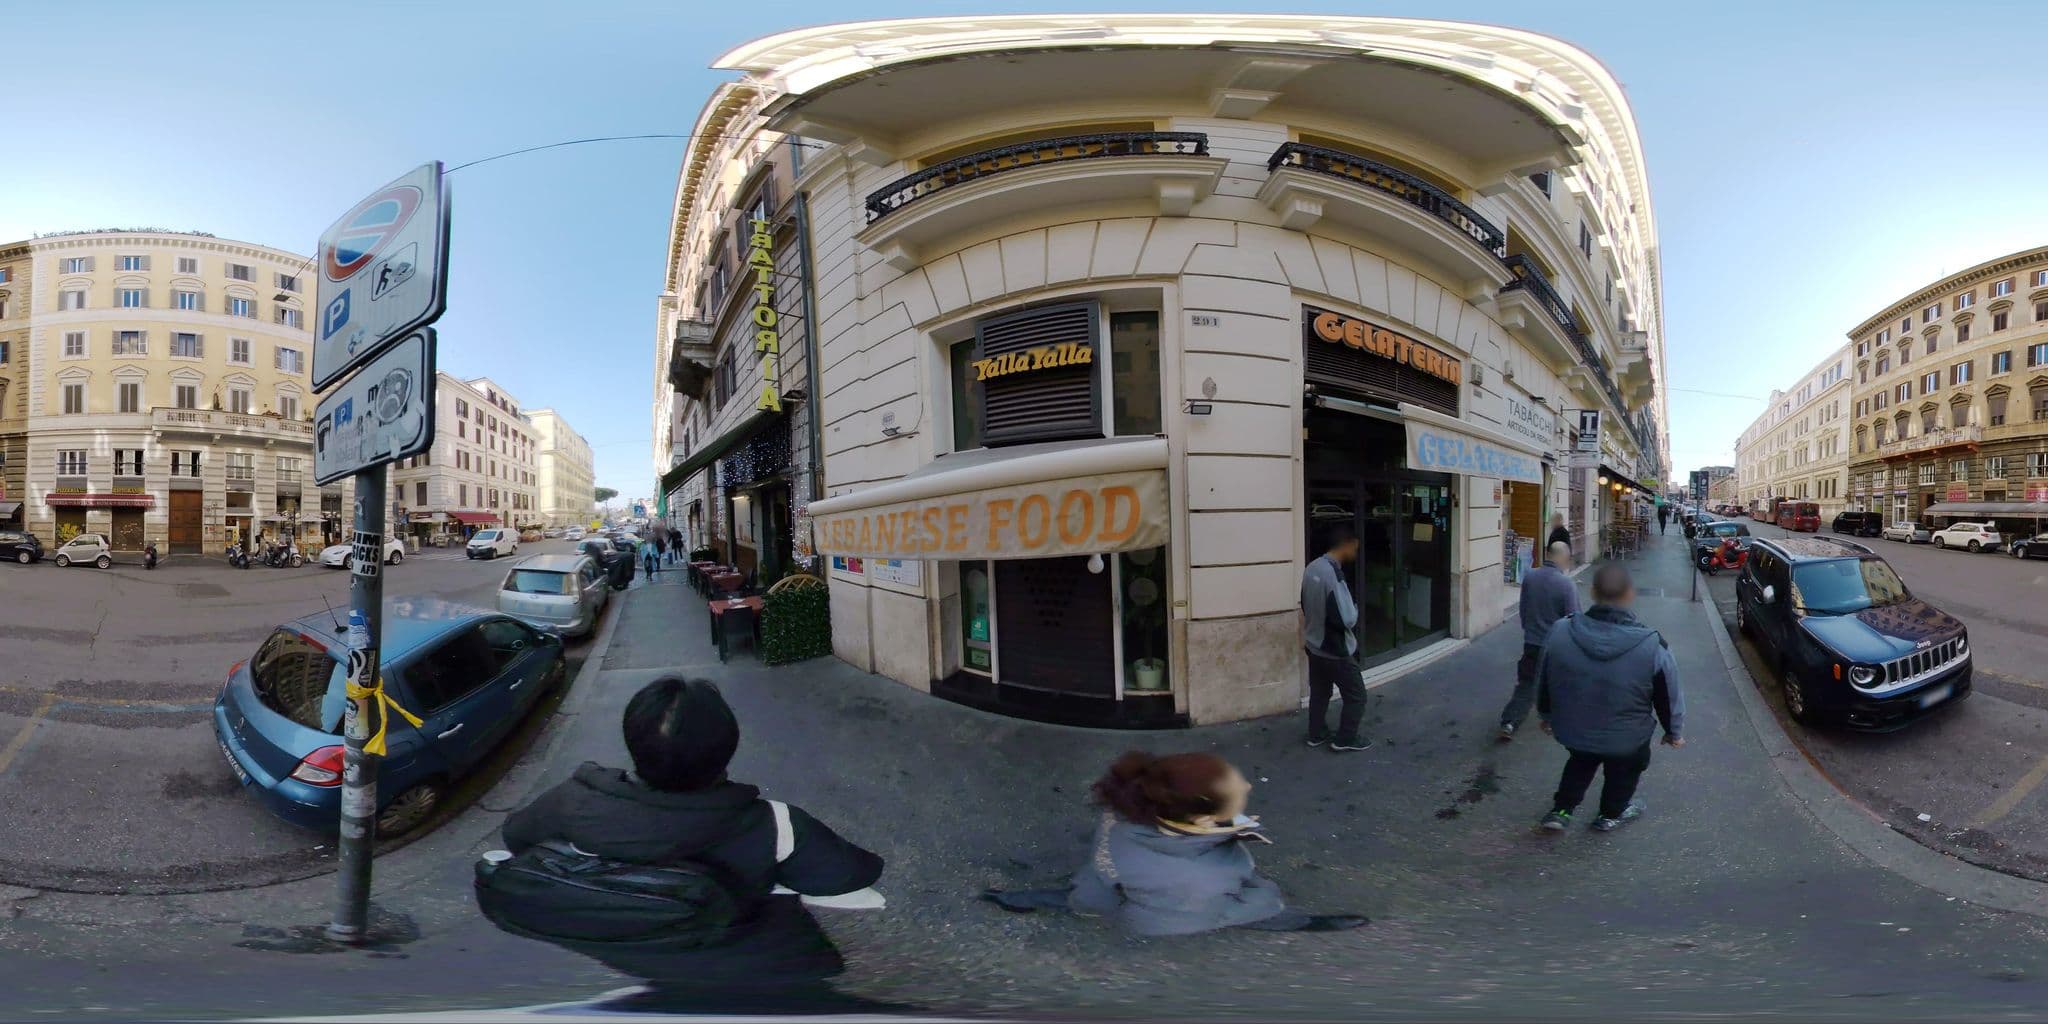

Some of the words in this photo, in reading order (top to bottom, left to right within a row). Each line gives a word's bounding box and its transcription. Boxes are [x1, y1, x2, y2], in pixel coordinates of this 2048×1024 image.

[972, 352, 1029, 381] Yalla
[1029, 341, 1093, 369] Yalla
[1314, 312, 1461, 385] GELATERIA
[820, 504, 970, 553] LEBANESE
[987, 485, 1141, 550] FOOD
[1916, 640, 1931, 649] Jeep
